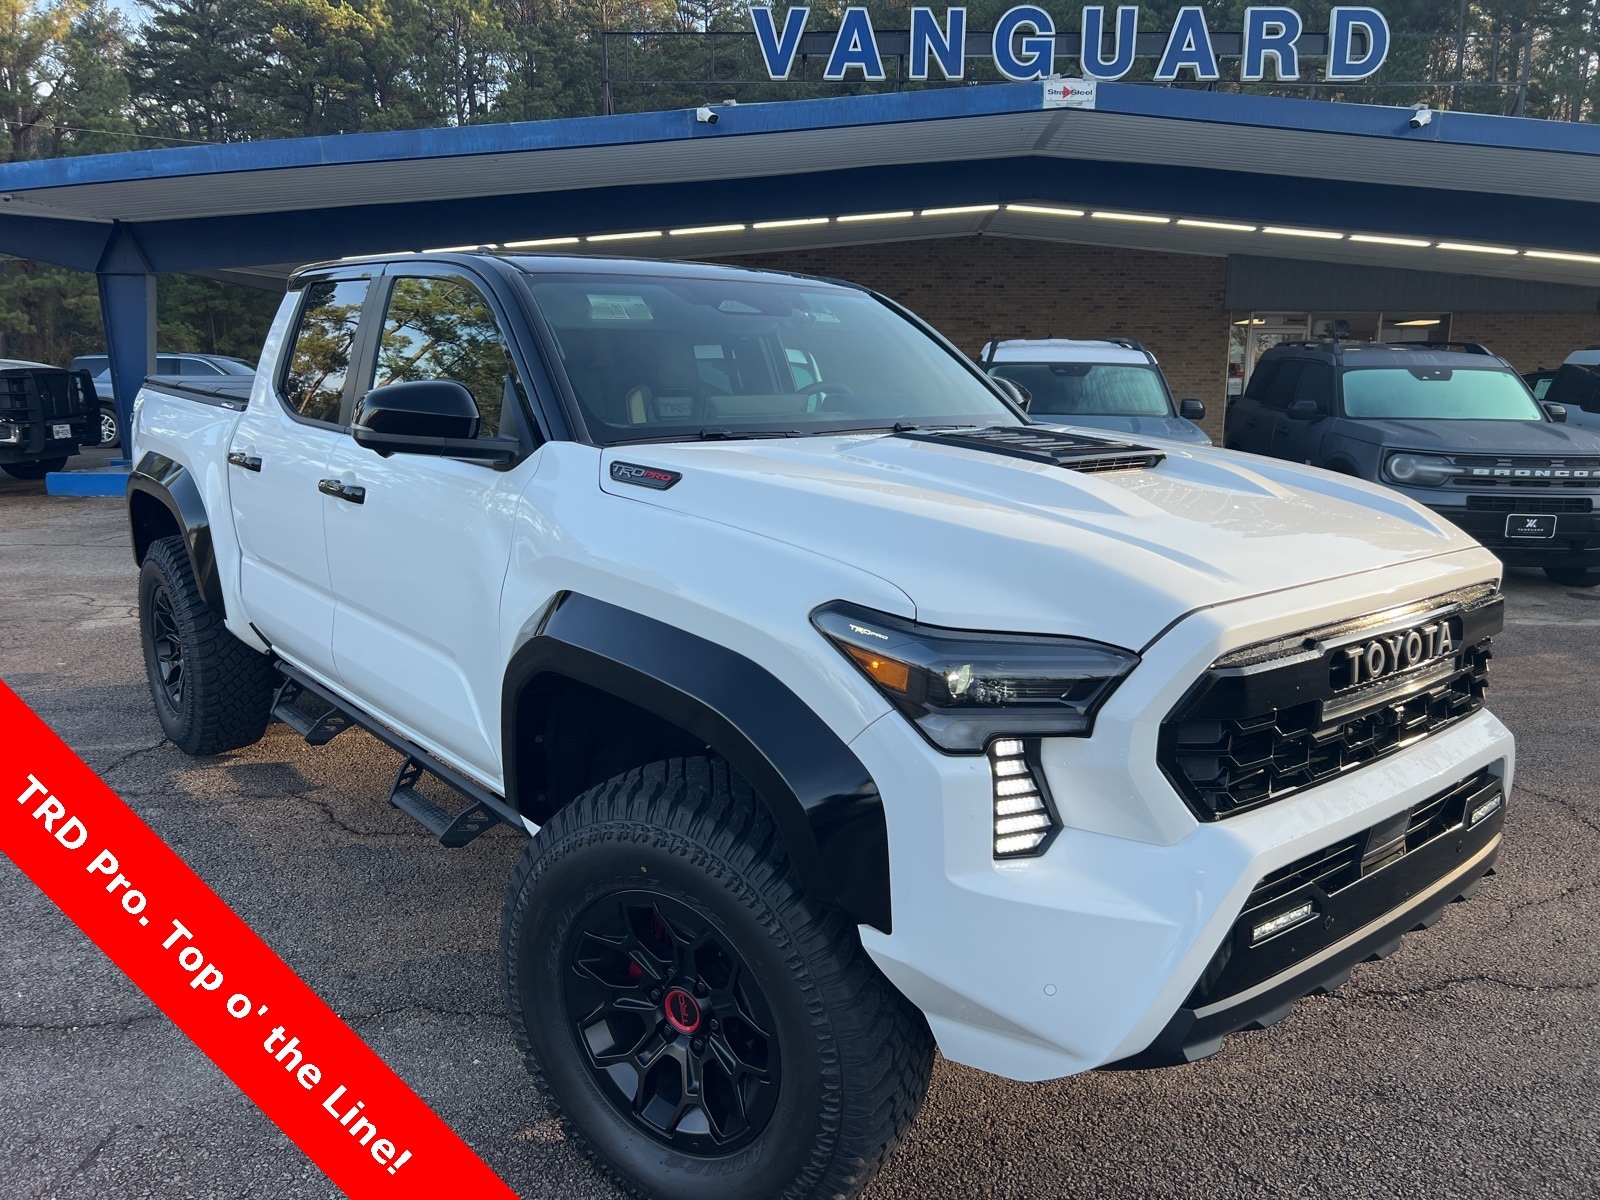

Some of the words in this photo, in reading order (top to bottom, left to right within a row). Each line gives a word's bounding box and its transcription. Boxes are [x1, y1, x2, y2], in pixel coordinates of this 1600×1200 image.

[749, 6, 1390, 81] VANGUARD
[1070, 88, 1093, 96] Steel
[1472, 468, 1589, 477] BRONCO
[1345, 621, 1453, 683] TOYOTA
